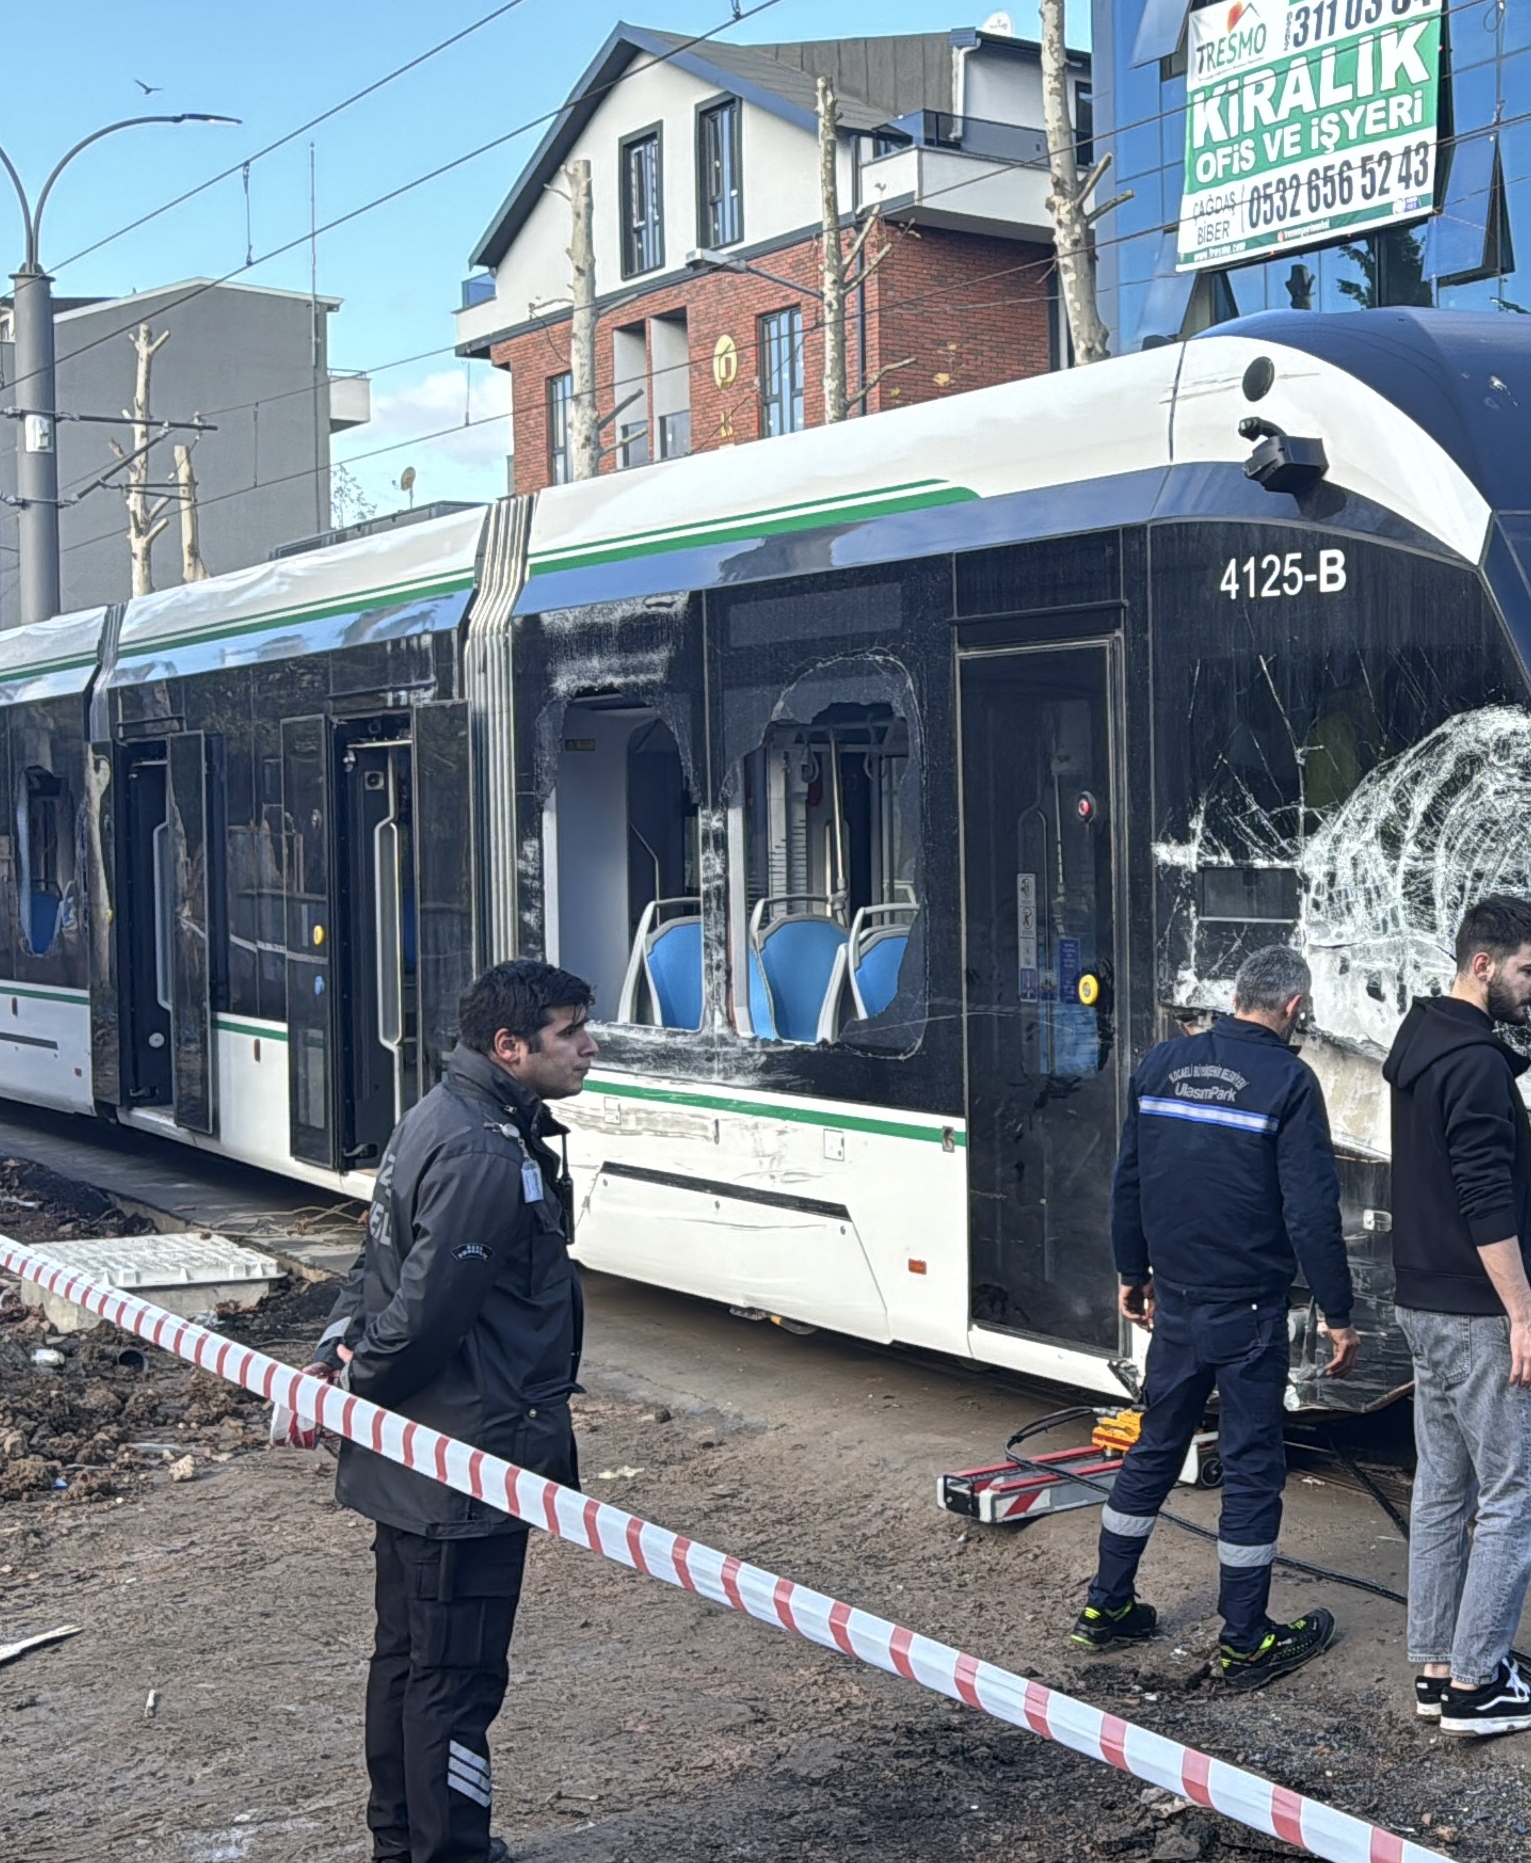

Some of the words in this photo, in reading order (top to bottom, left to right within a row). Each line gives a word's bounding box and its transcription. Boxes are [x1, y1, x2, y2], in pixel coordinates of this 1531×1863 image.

[1196, 23, 1267, 74] TRESMO
[1293, 0, 1337, 48] 311
[1193, 20, 1431, 149] KİRALIK
[1195, 139, 1256, 183] OFİS
[1262, 123, 1301, 163] VE
[1310, 90, 1424, 155] İŞYERİ
[1193, 191, 1236, 226] ÇAĞDAŞ
[1249, 173, 1301, 229] 0532
[1308, 159, 1353, 214] 656
[1361, 150, 1391, 200] 52
[1399, 140, 1430, 191] 43
[1197, 220, 1230, 246] BİBER
[1220, 549, 1347, 600] 4125-B
